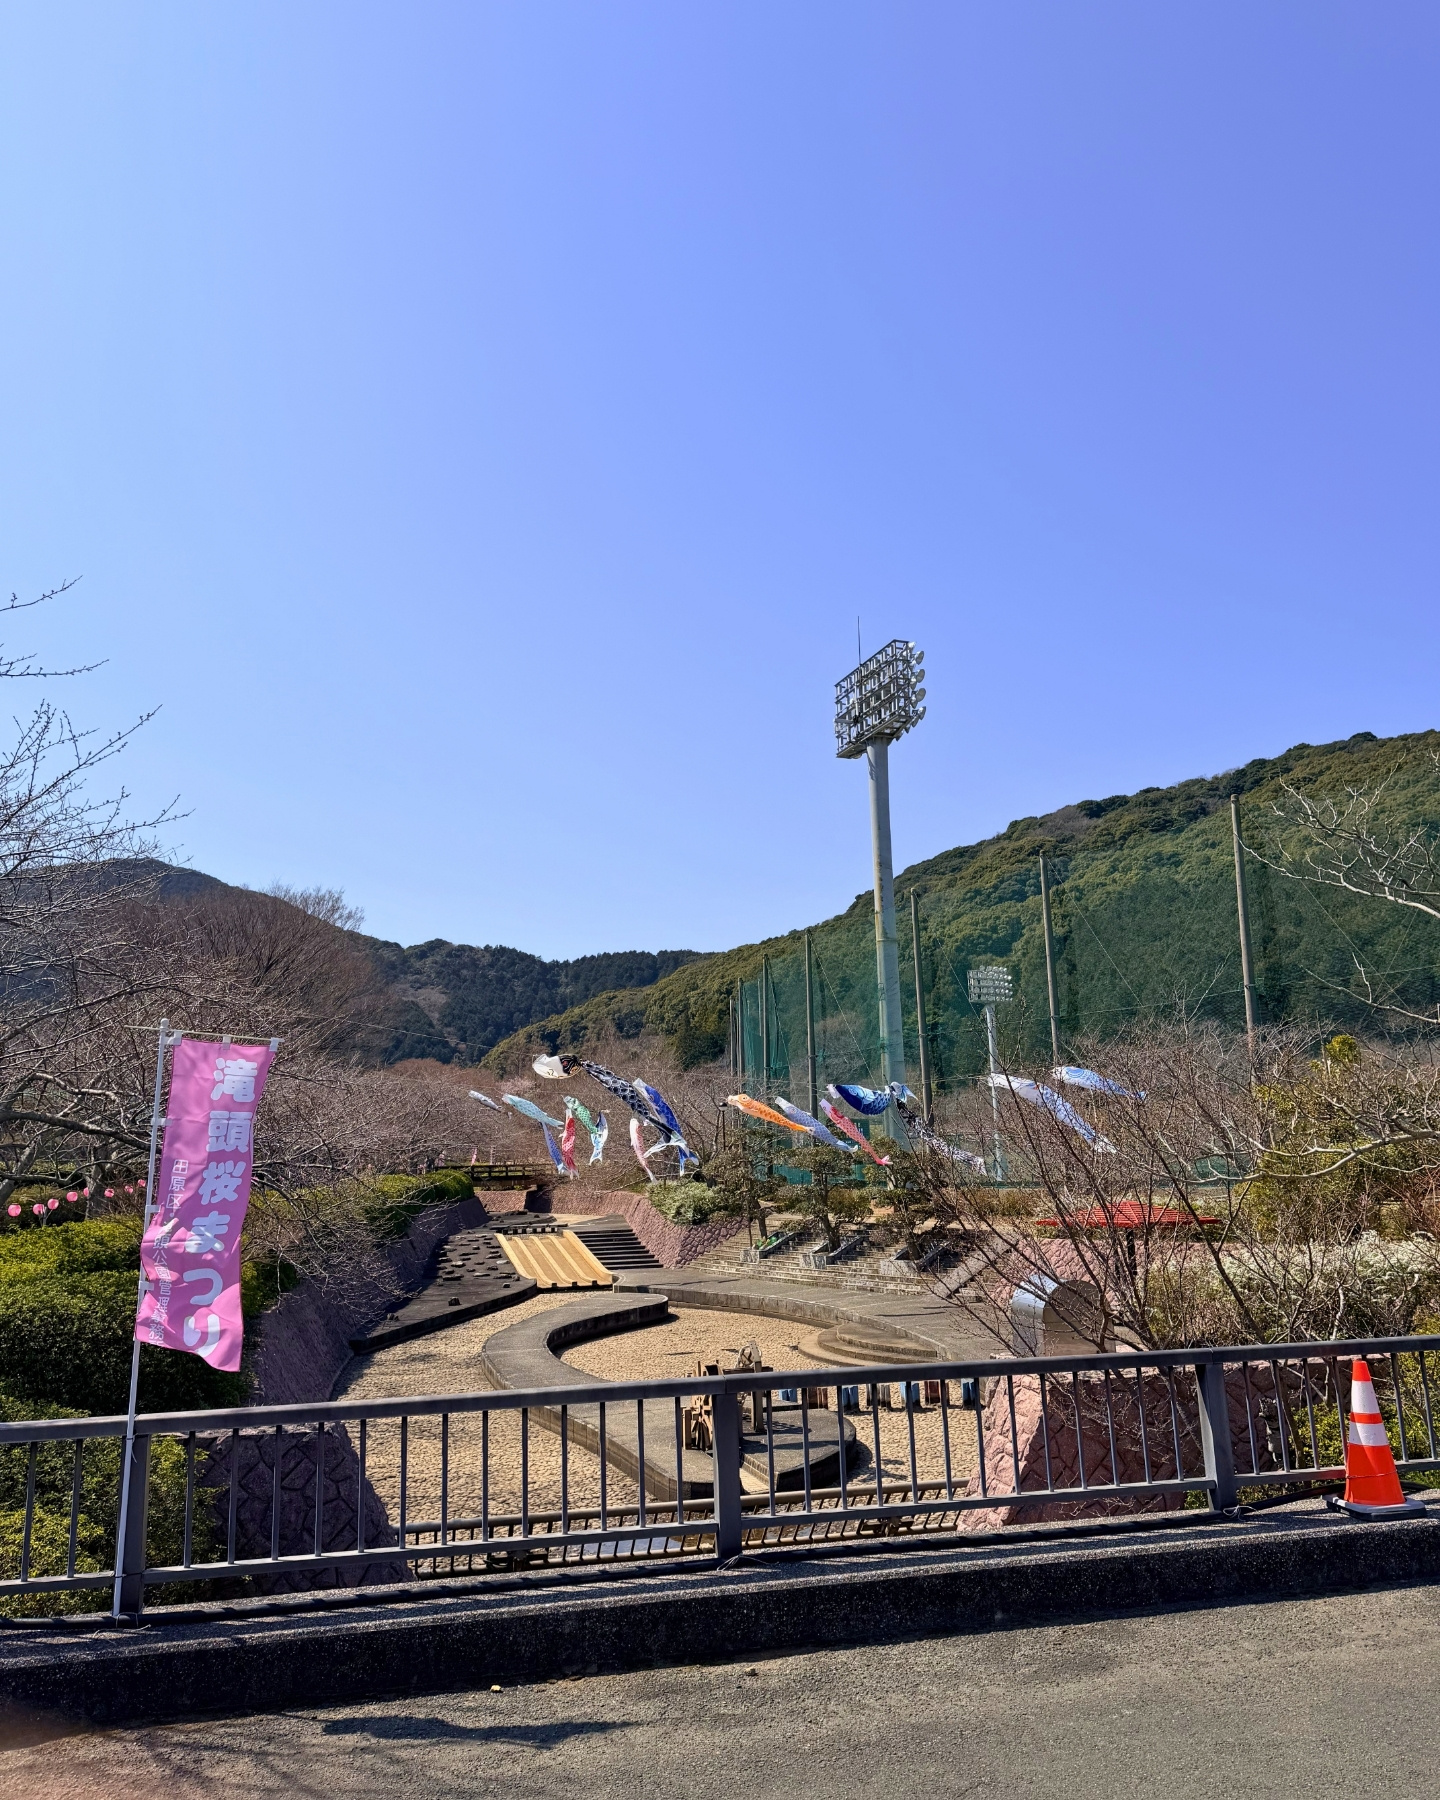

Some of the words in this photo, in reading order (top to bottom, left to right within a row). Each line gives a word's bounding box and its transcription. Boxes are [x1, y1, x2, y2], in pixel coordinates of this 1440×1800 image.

[183, 1058, 258, 1358] 滝頭桜まつり
